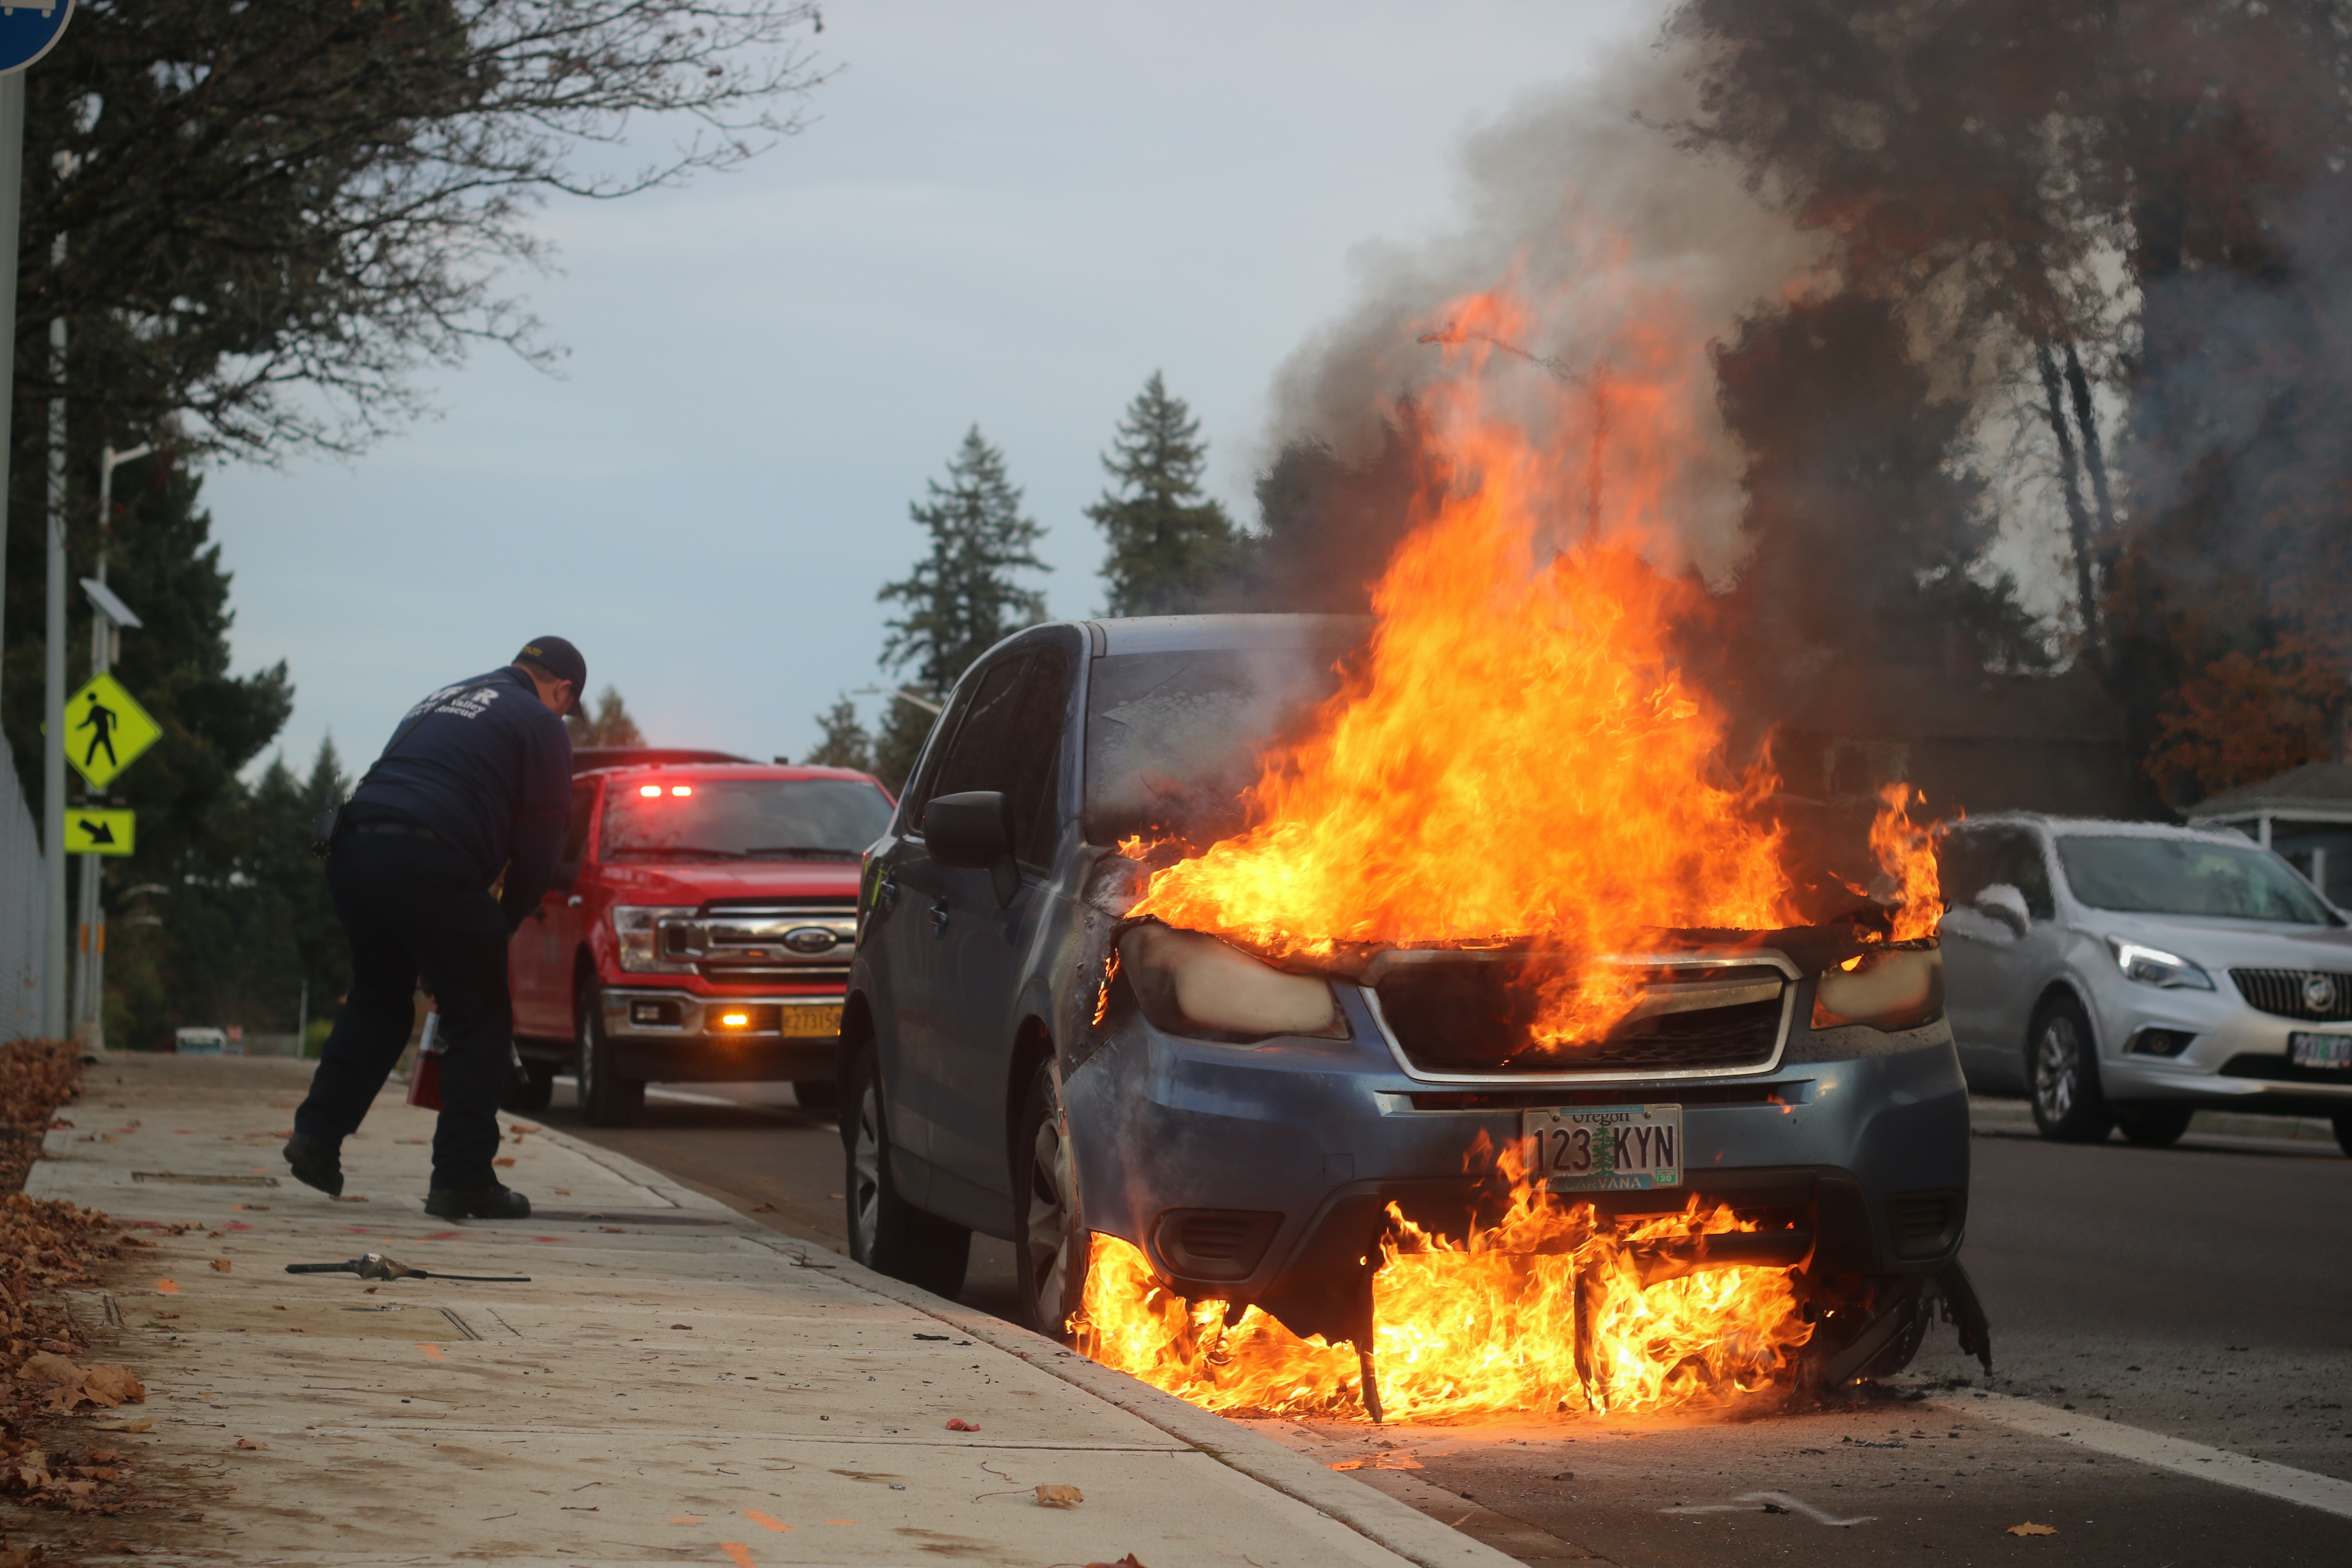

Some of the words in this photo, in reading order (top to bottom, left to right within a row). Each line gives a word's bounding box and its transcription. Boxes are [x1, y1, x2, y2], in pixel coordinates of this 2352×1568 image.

[1573, 1113, 1631, 1126] Oregon
[1535, 1129, 1592, 1171] 123
[1614, 1126, 1673, 1169] KYN
[1565, 1177, 1641, 1190] CARVANA
